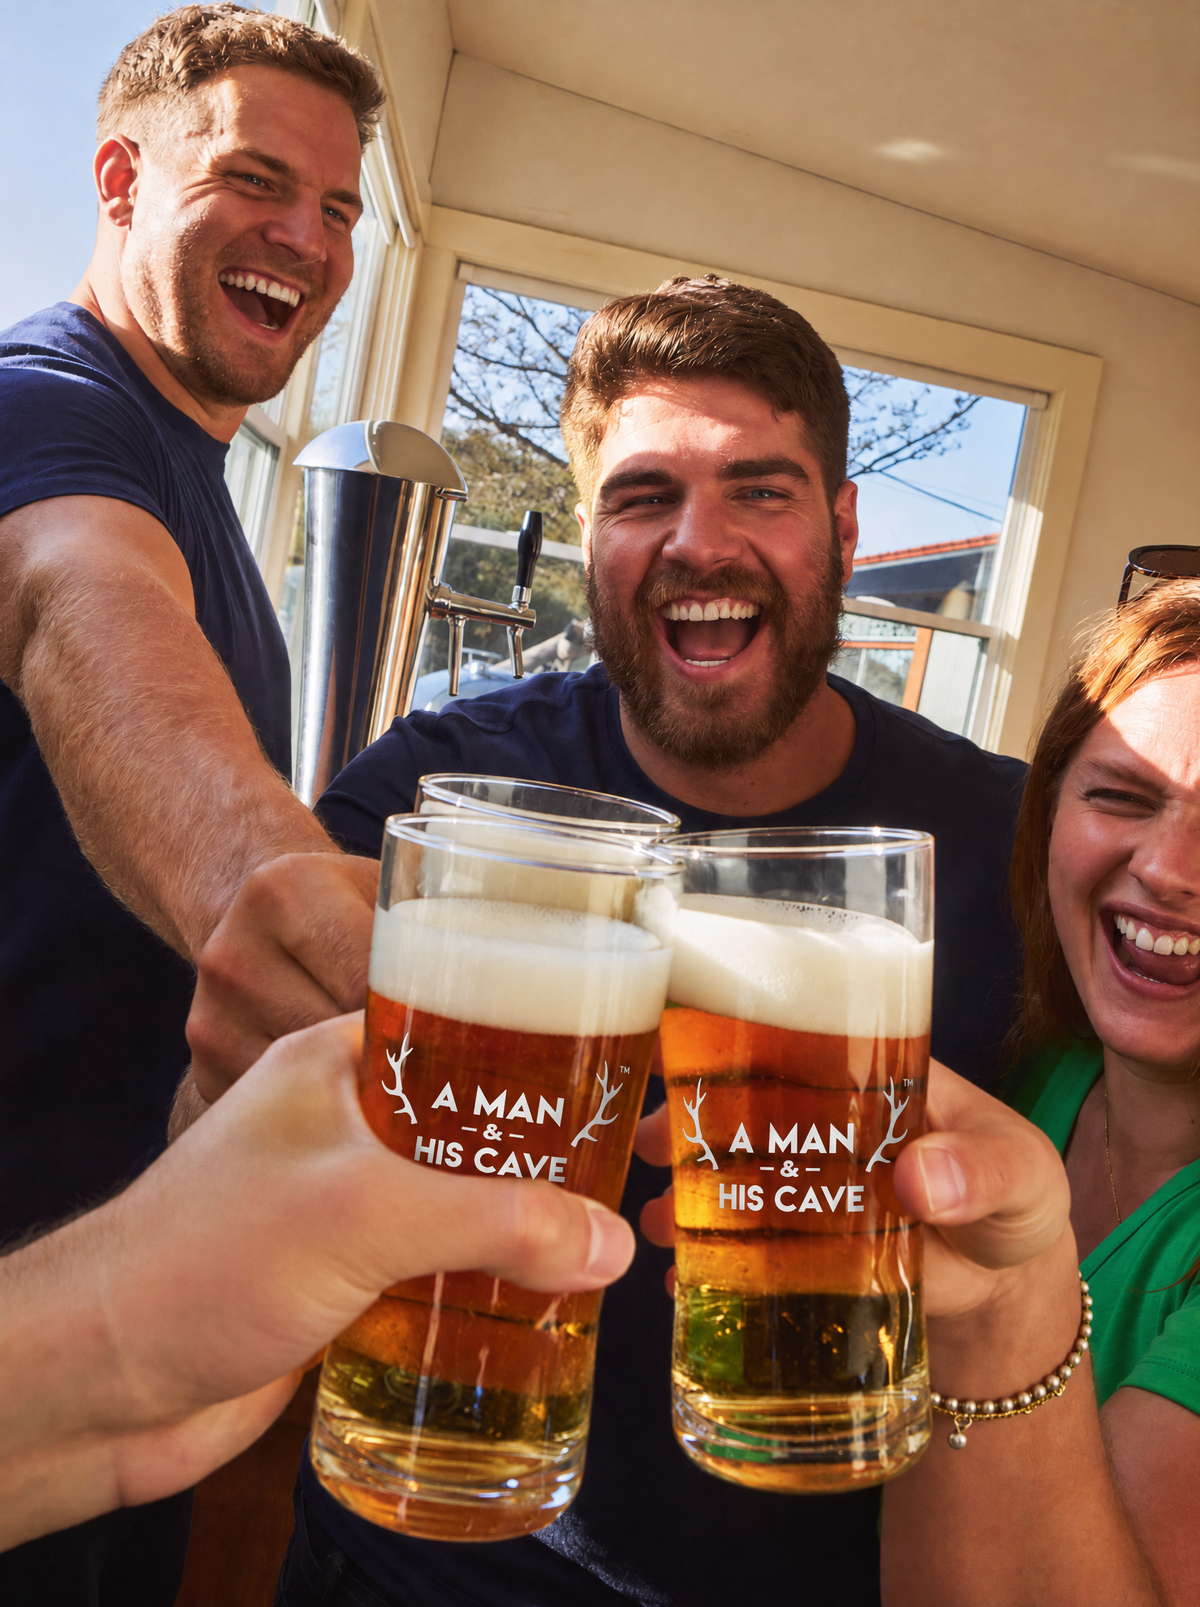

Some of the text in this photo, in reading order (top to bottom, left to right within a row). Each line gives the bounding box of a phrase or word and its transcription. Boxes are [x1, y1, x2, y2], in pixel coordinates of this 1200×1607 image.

[430, 1081, 565, 1127] A MAN
[728, 1122, 855, 1154] A MAN
[413, 1135, 568, 1183] HIS CAVE
[718, 1183, 865, 1213] HIS CAVE
